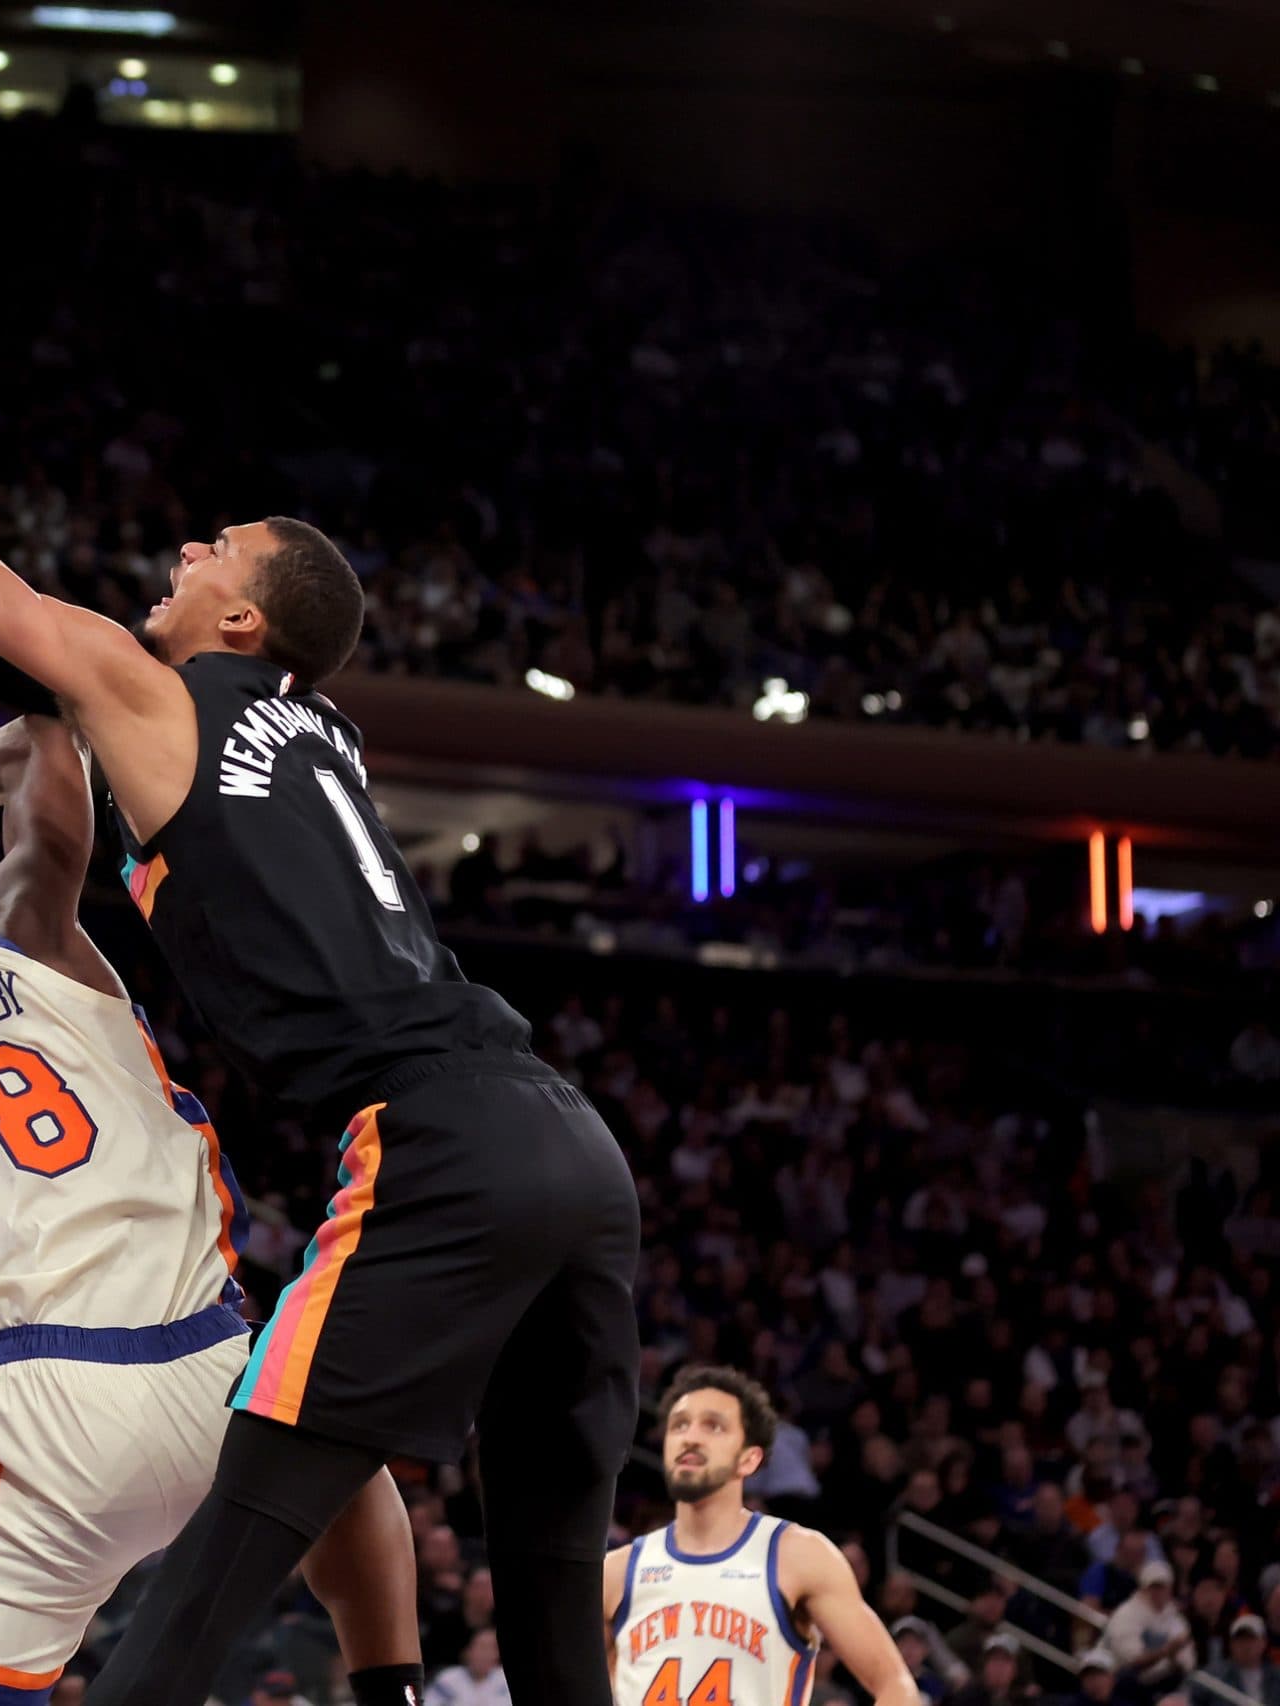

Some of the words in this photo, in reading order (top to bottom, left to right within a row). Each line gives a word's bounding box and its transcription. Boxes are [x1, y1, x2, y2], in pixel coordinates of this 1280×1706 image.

[313, 765, 406, 913] 1
[629, 1602, 683, 1665] NEW
[690, 1600, 768, 1664] YORK
[642, 1656, 735, 1706] 44
